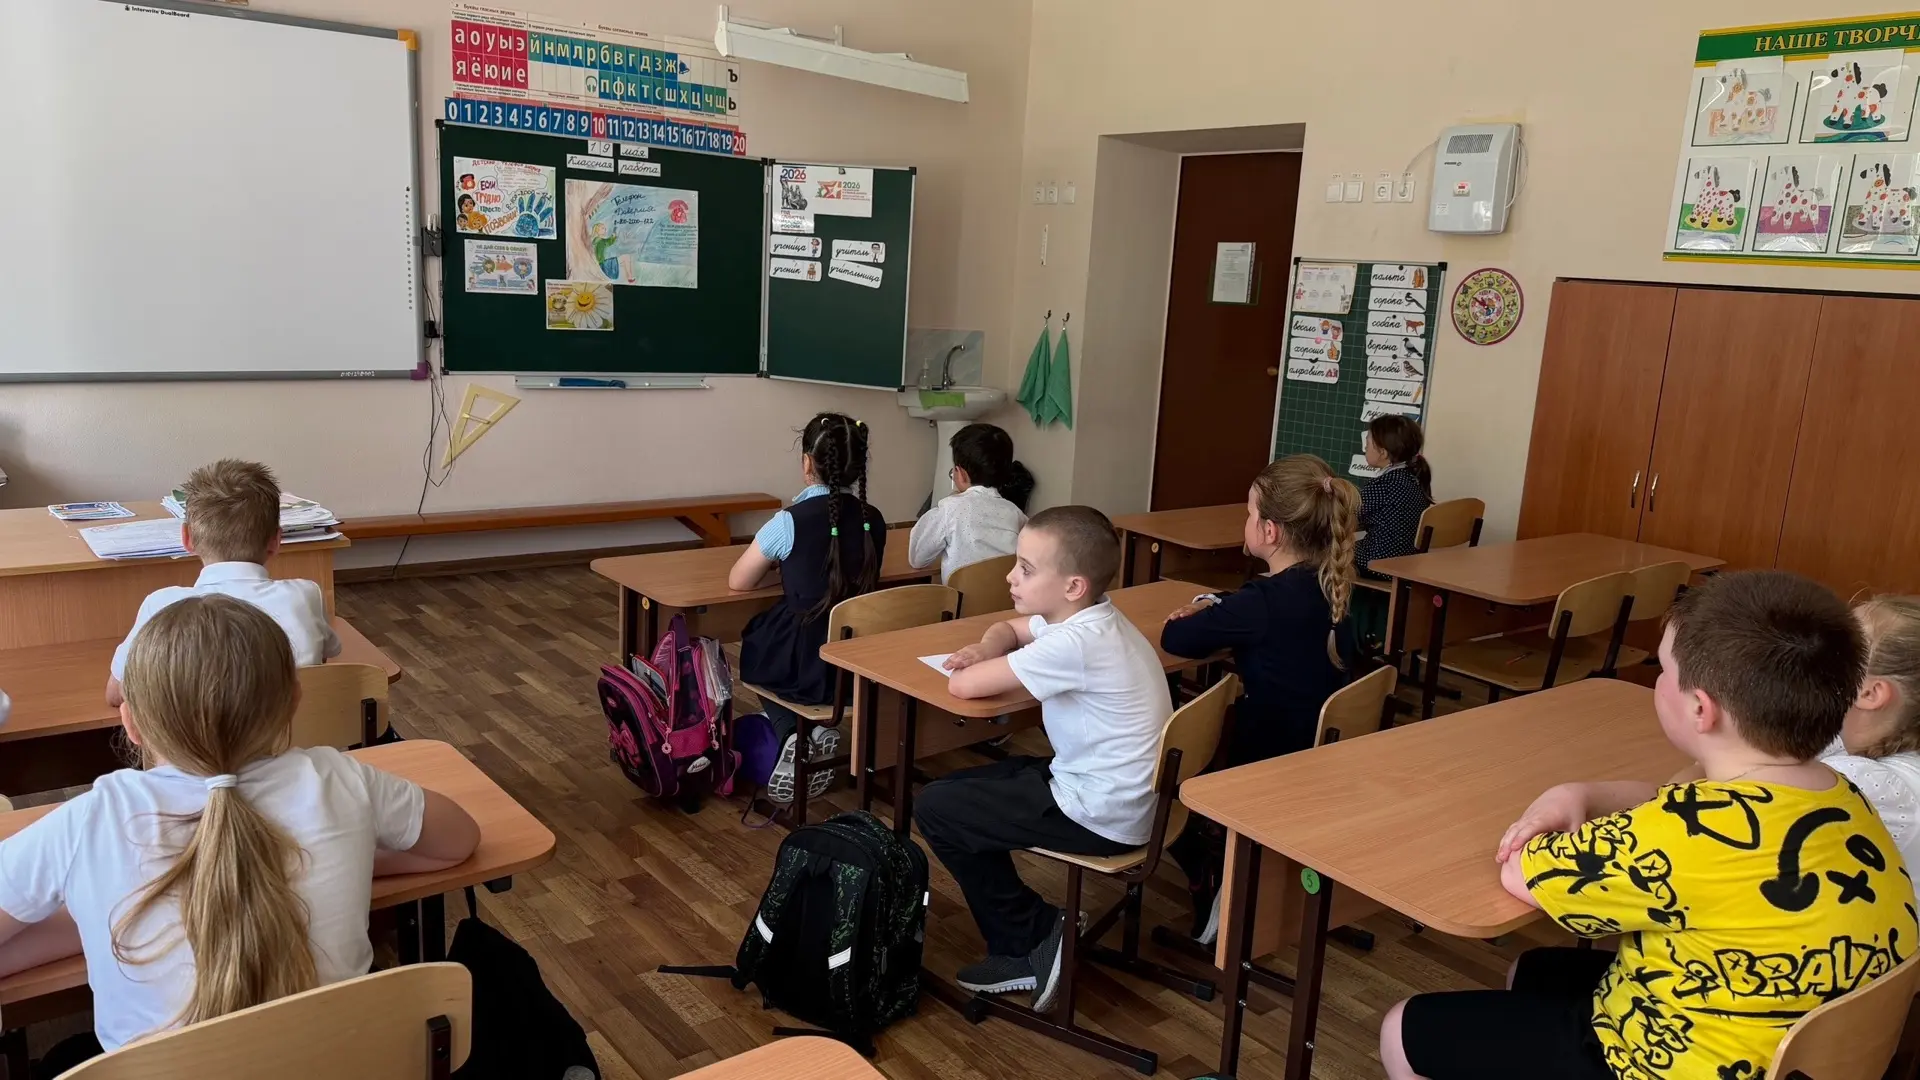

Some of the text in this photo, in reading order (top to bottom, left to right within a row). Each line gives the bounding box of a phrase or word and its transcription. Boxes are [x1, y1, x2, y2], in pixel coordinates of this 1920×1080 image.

[1754, 32, 1828, 52] НАШЕ
[448, 102, 745, 153] 0 1 2 3 4 5 6 7 8 9 10 11 12 13 14 15 16 17 18 19 20
[782, 168, 806, 180] 2026
[480, 180, 496, 190] ЕСЛИ
[475, 192, 502, 205] ТРУДНО
[1306, 874, 1314, 888] 5
